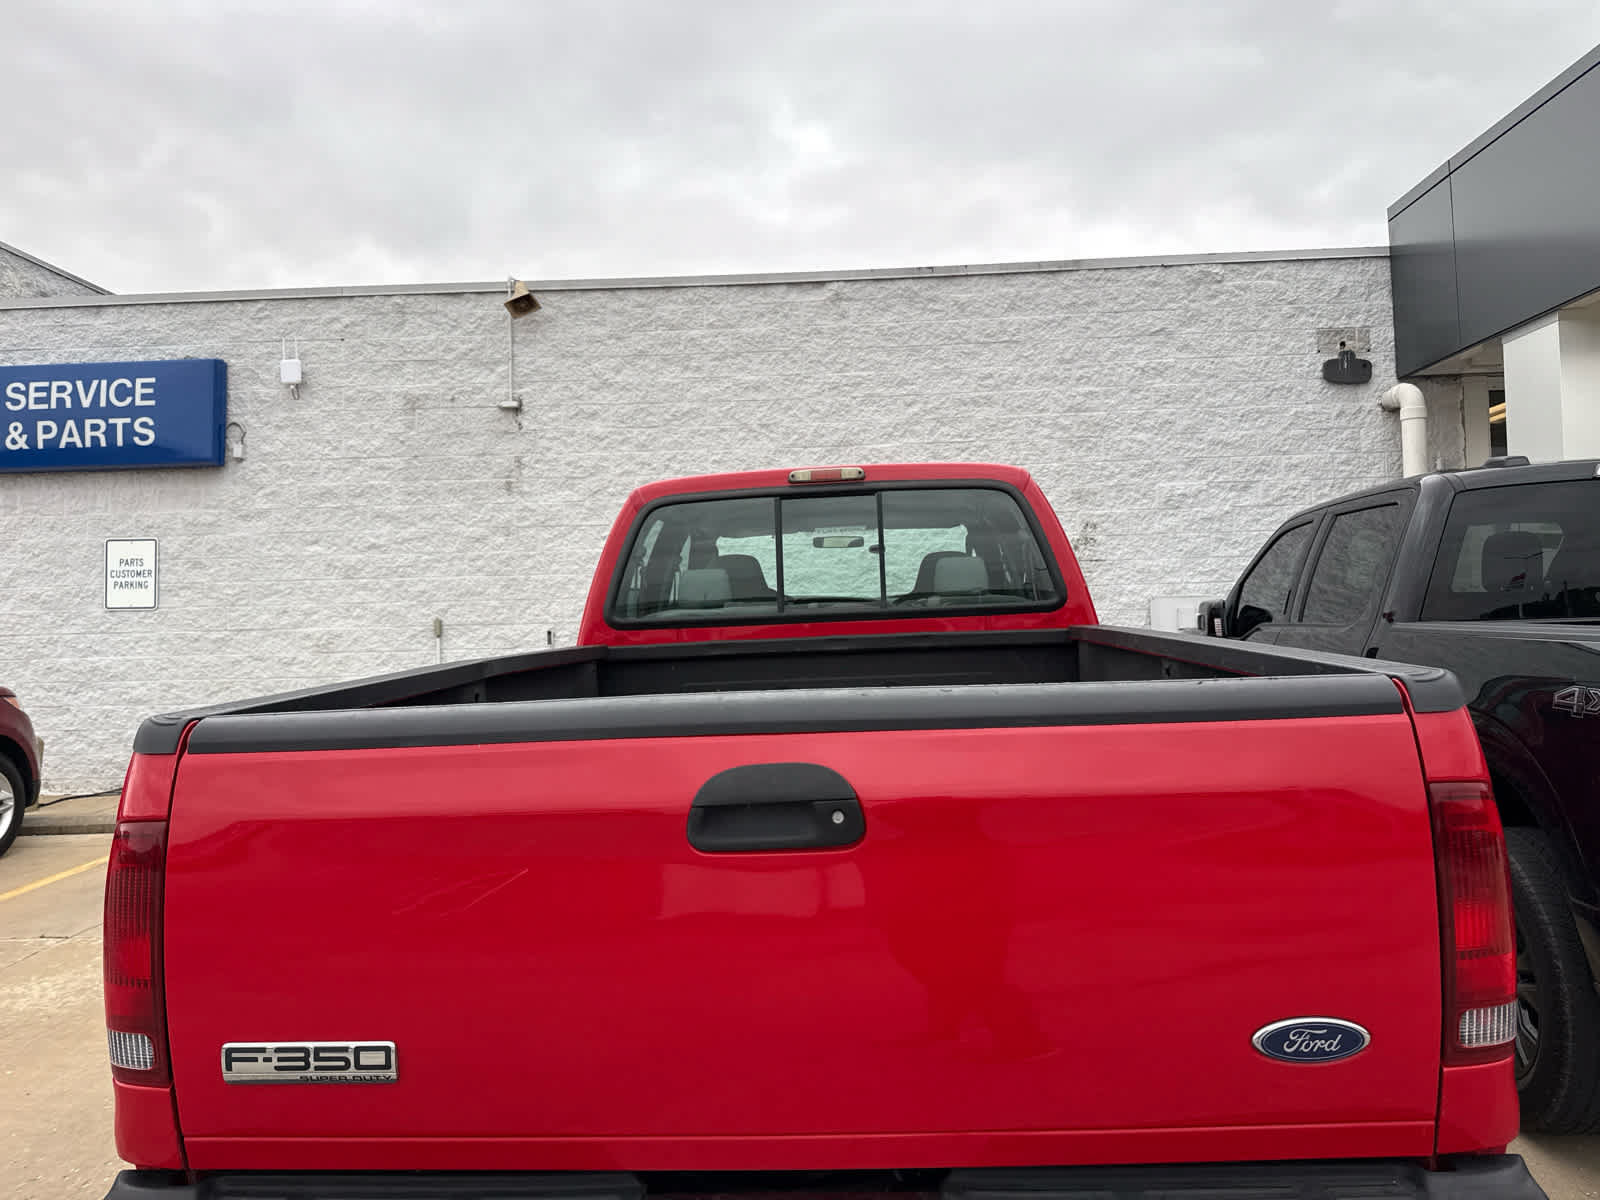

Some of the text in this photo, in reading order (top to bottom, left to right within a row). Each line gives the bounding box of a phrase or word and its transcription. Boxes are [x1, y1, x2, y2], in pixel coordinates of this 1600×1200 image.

[5, 377, 156, 411] SERVICE
[4, 416, 156, 450] & PARTS
[110, 569, 153, 578] CUSTOMER
[119, 558, 144, 567] PARTS
[113, 580, 149, 590] PARKING
[1283, 1028, 1342, 1053] Ford
[224, 1045, 392, 1072] F-350
